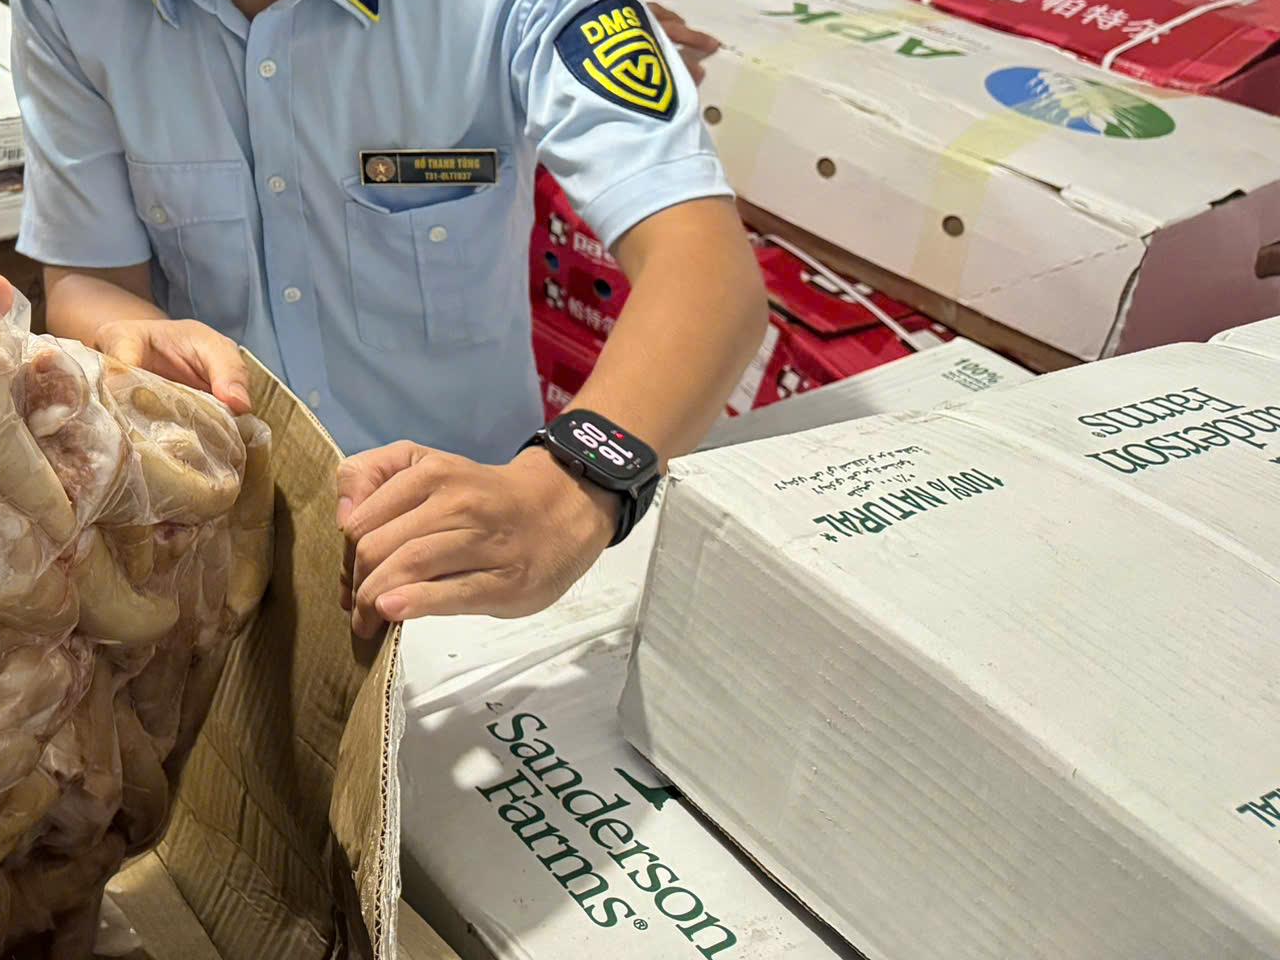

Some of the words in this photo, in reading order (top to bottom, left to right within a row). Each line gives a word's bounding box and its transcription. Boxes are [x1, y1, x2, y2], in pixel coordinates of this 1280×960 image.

[580, 6, 641, 45] DMS
[599, 439, 634, 466] 16
[1084, 405, 1280, 474] nderson
[926, 468, 1005, 501] 100%
[486, 712, 738, 960] Sanderson
